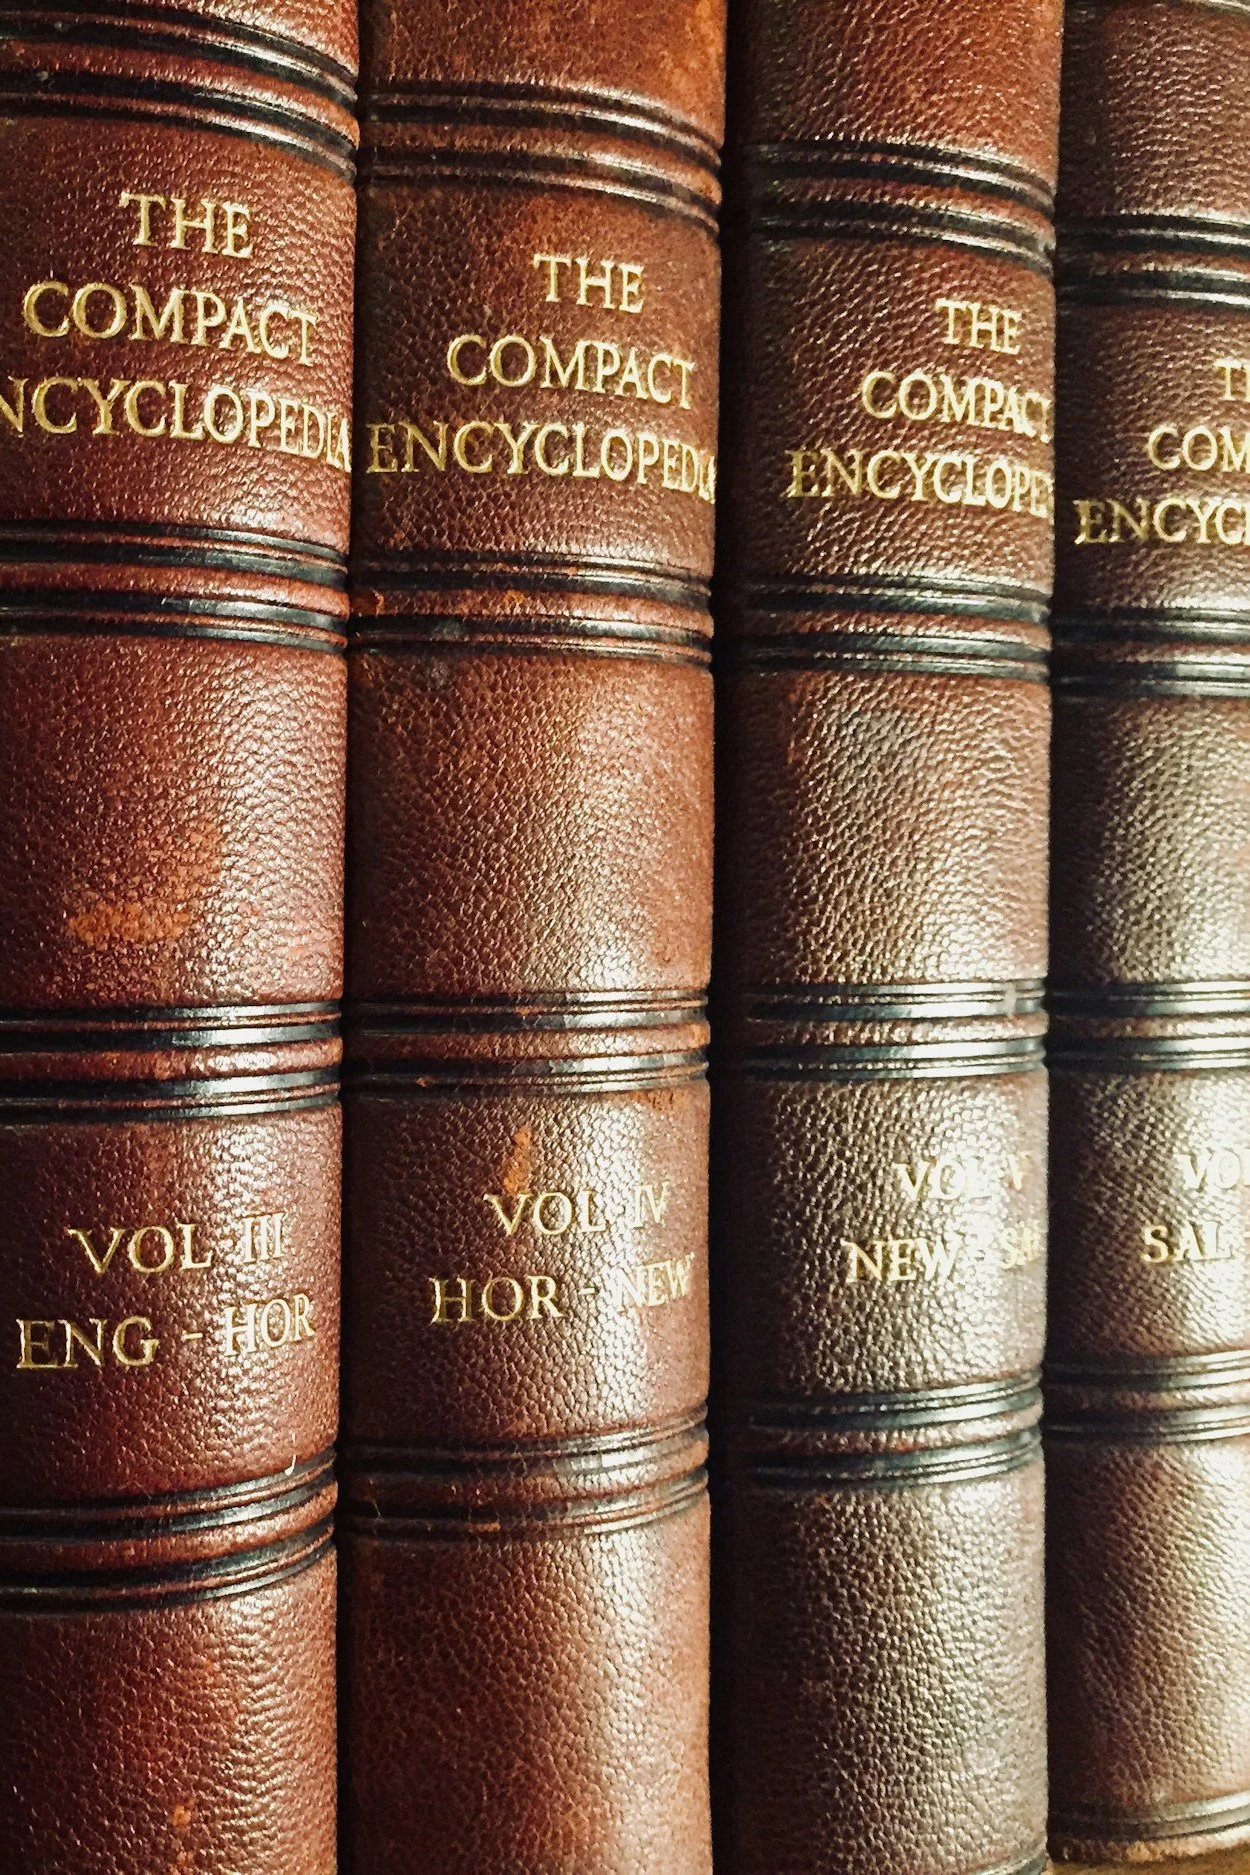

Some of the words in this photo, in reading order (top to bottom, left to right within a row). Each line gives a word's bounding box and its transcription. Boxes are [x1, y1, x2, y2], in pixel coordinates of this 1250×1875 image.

[119, 191, 253, 259] THE
[533, 253, 645, 314] THE
[23, 280, 317, 367] COMPACT
[935, 298, 1022, 354] THE
[447, 334, 696, 410] COMPACT
[1213, 357, 1250, 402] T
[66, 1222, 213, 1275] VOL
[241, 1211, 287, 1263] III
[483, 1189, 607, 1236] VOL
[429, 1275, 567, 1325] HOR
[614, 1252, 696, 1312] NEW
[840, 1235, 964, 1284] NEW
[16, 1316, 160, 1369] ENG
[223, 1292, 317, 1357] HOR
